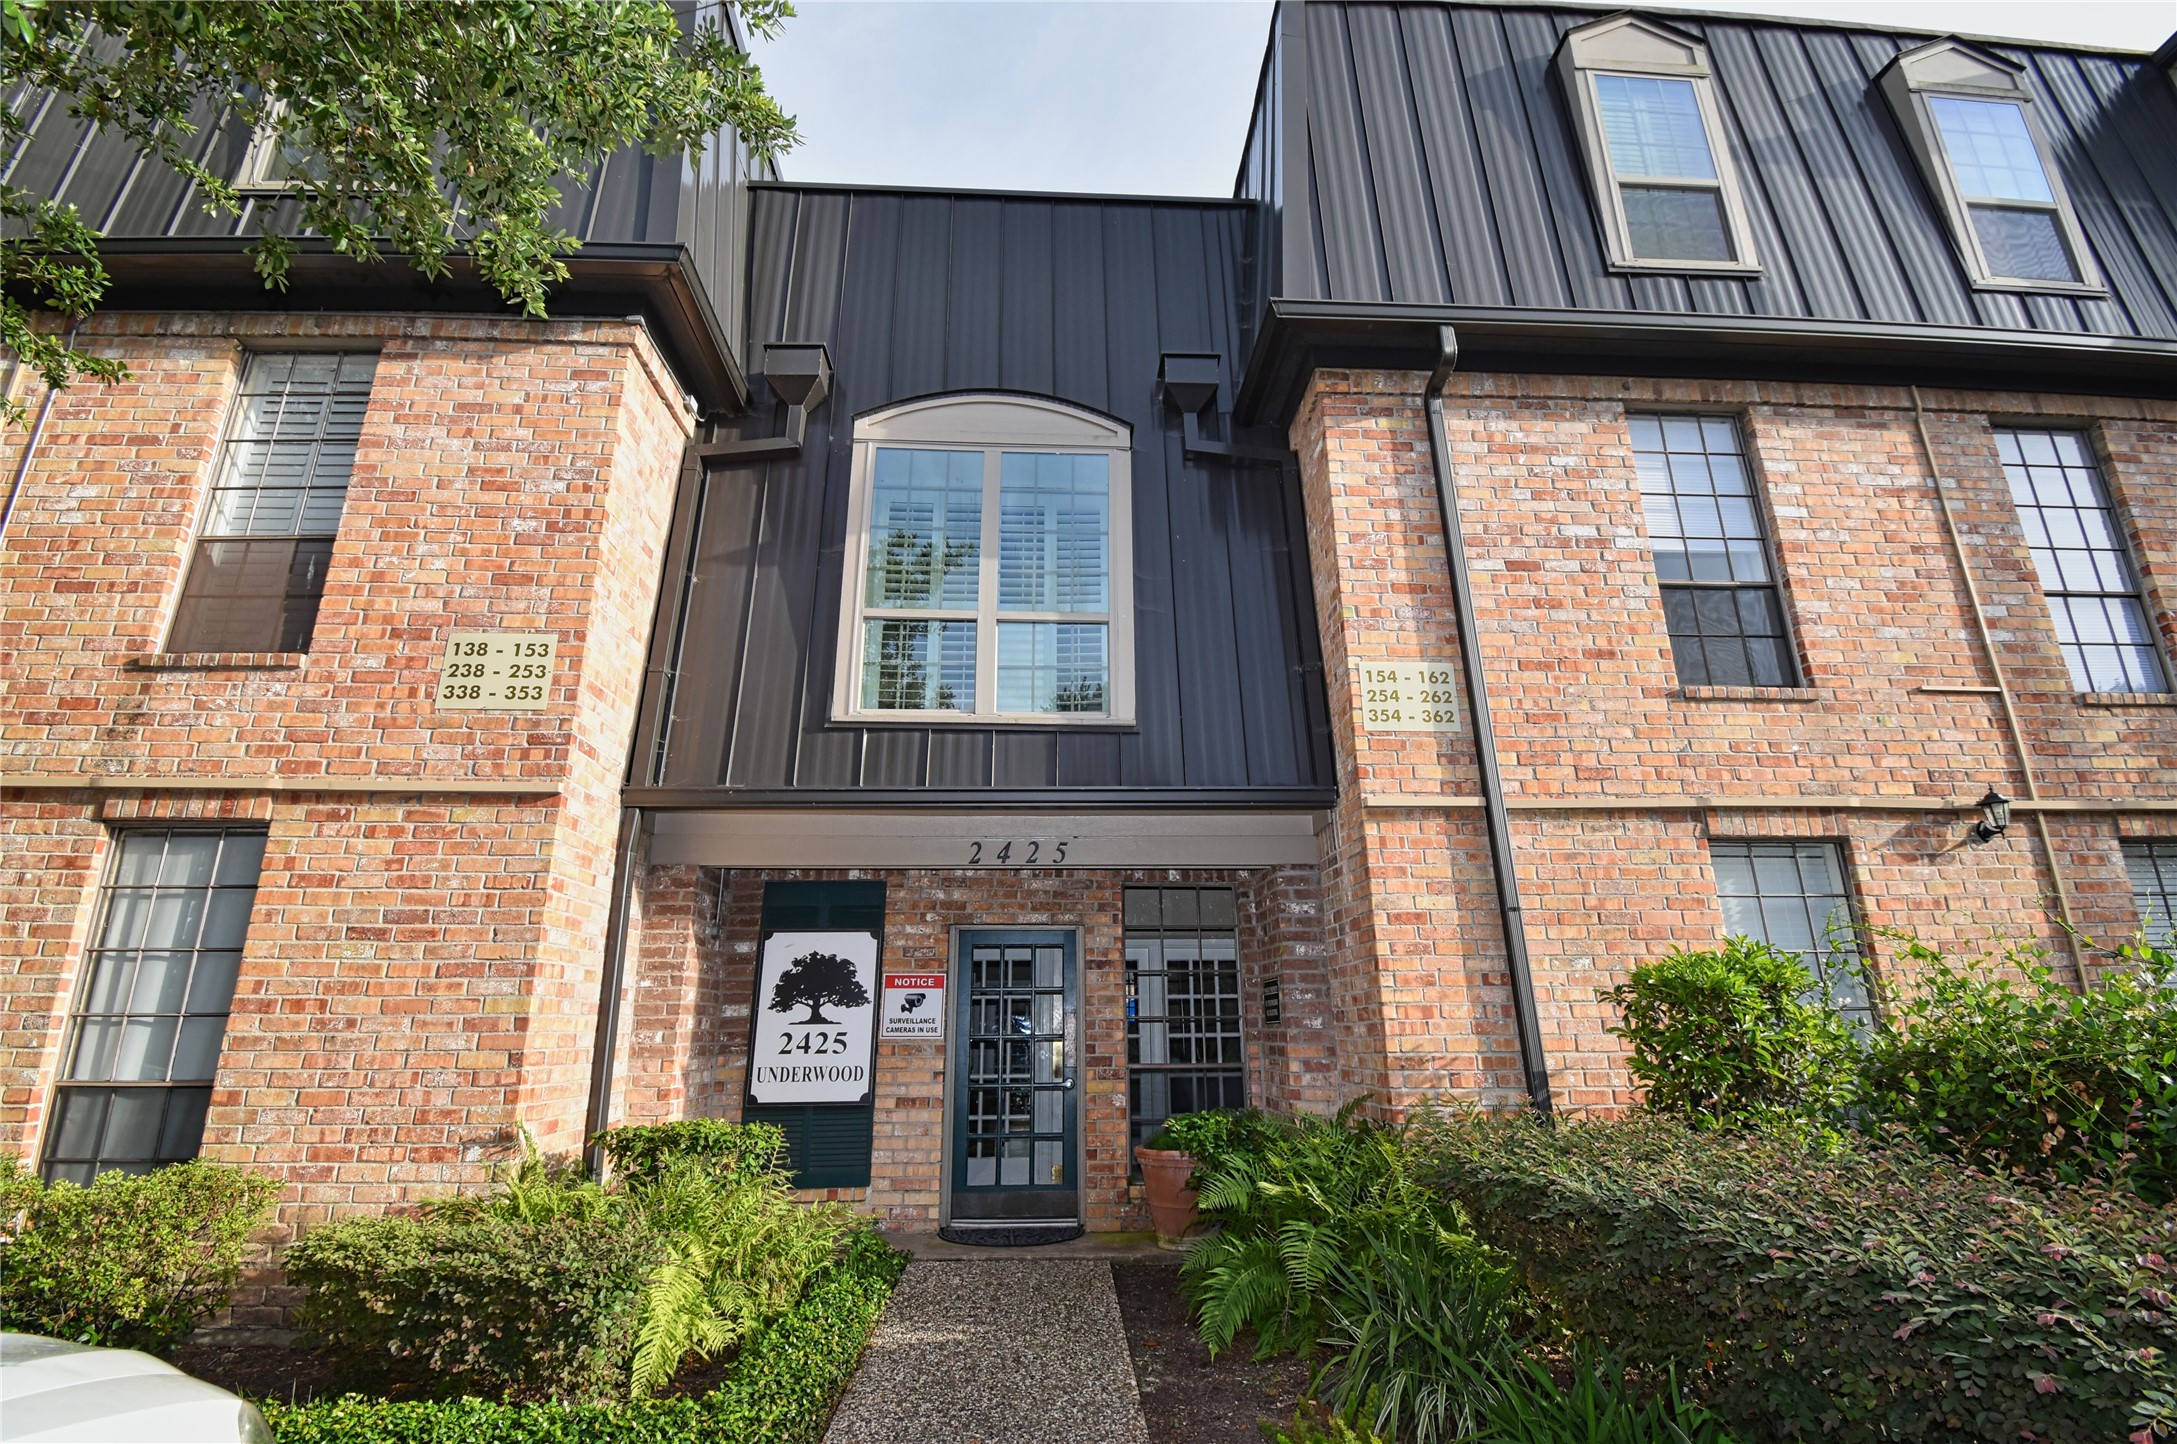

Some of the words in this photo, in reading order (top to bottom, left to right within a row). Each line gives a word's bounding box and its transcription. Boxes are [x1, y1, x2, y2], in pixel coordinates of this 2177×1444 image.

[453, 642, 488, 656] 138
[514, 643, 549, 657] 153
[447, 663, 485, 678] 238
[508, 664, 547, 678] 253
[1365, 670, 1397, 683] 154
[1418, 671, 1450, 684] 162
[443, 685, 481, 699] 338
[504, 686, 543, 700] 353
[1366, 690, 1400, 702] 254
[1419, 690, 1453, 703] 262
[1368, 709, 1401, 722] 354
[1421, 710, 1455, 723] 362
[968, 841, 1068, 864] 2425
[894, 978, 935, 986] NOTICE
[778, 1032, 848, 1055] 2425
[757, 1066, 864, 1083] UNDERWOOD
